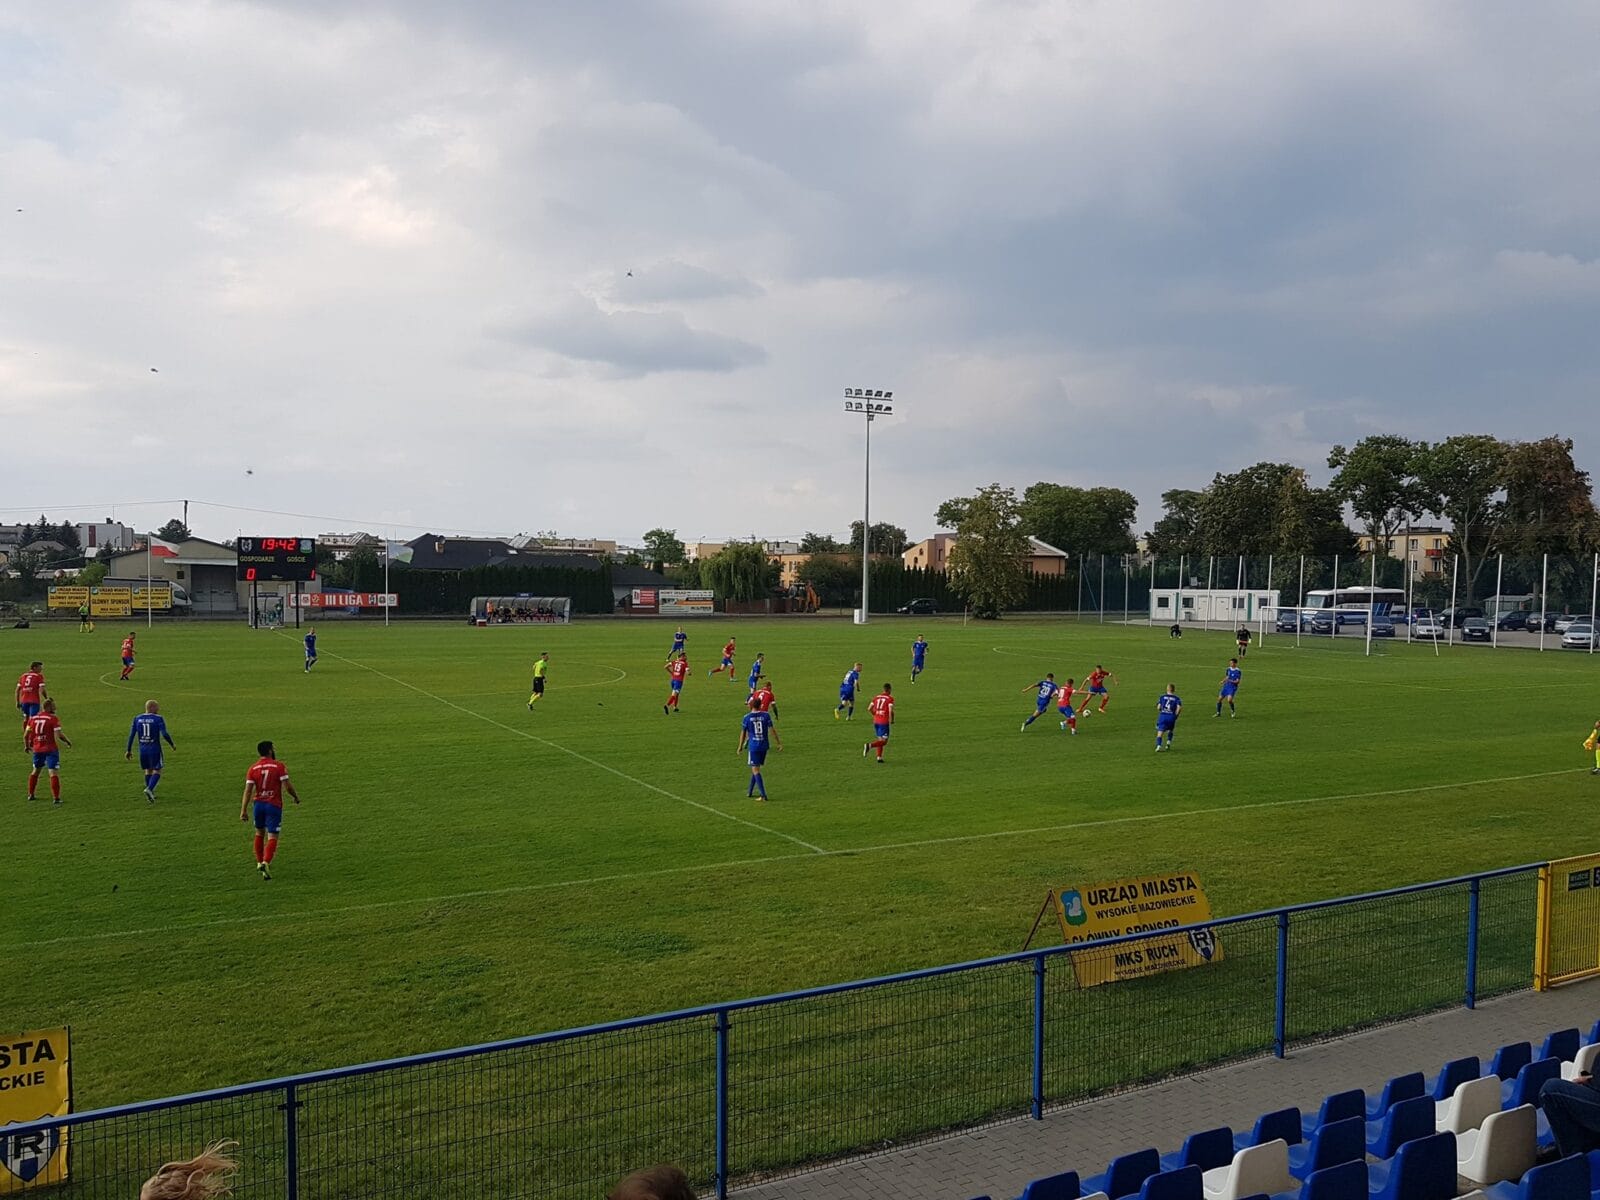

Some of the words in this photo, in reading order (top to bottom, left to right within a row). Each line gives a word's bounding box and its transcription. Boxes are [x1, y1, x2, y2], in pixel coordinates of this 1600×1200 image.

[261, 538, 296, 550] 19:42
[246, 568, 256, 580] 0
[325, 594, 337, 606] III
[339, 594, 364, 606] LIGA
[24, 675, 33, 687] 5
[34, 719, 46, 735] 77
[142, 723, 150, 737] 11
[261, 769, 269, 789] 7
[1088, 885, 1138, 906] URZĄD
[1142, 876, 1198, 898] MIASTA
[1095, 905, 1138, 920] WYSOKIE
[1139, 895, 1197, 913] MAZOWIECKIE
[1115, 951, 1144, 967] MKS
[1147, 944, 1179, 962] RUCH
